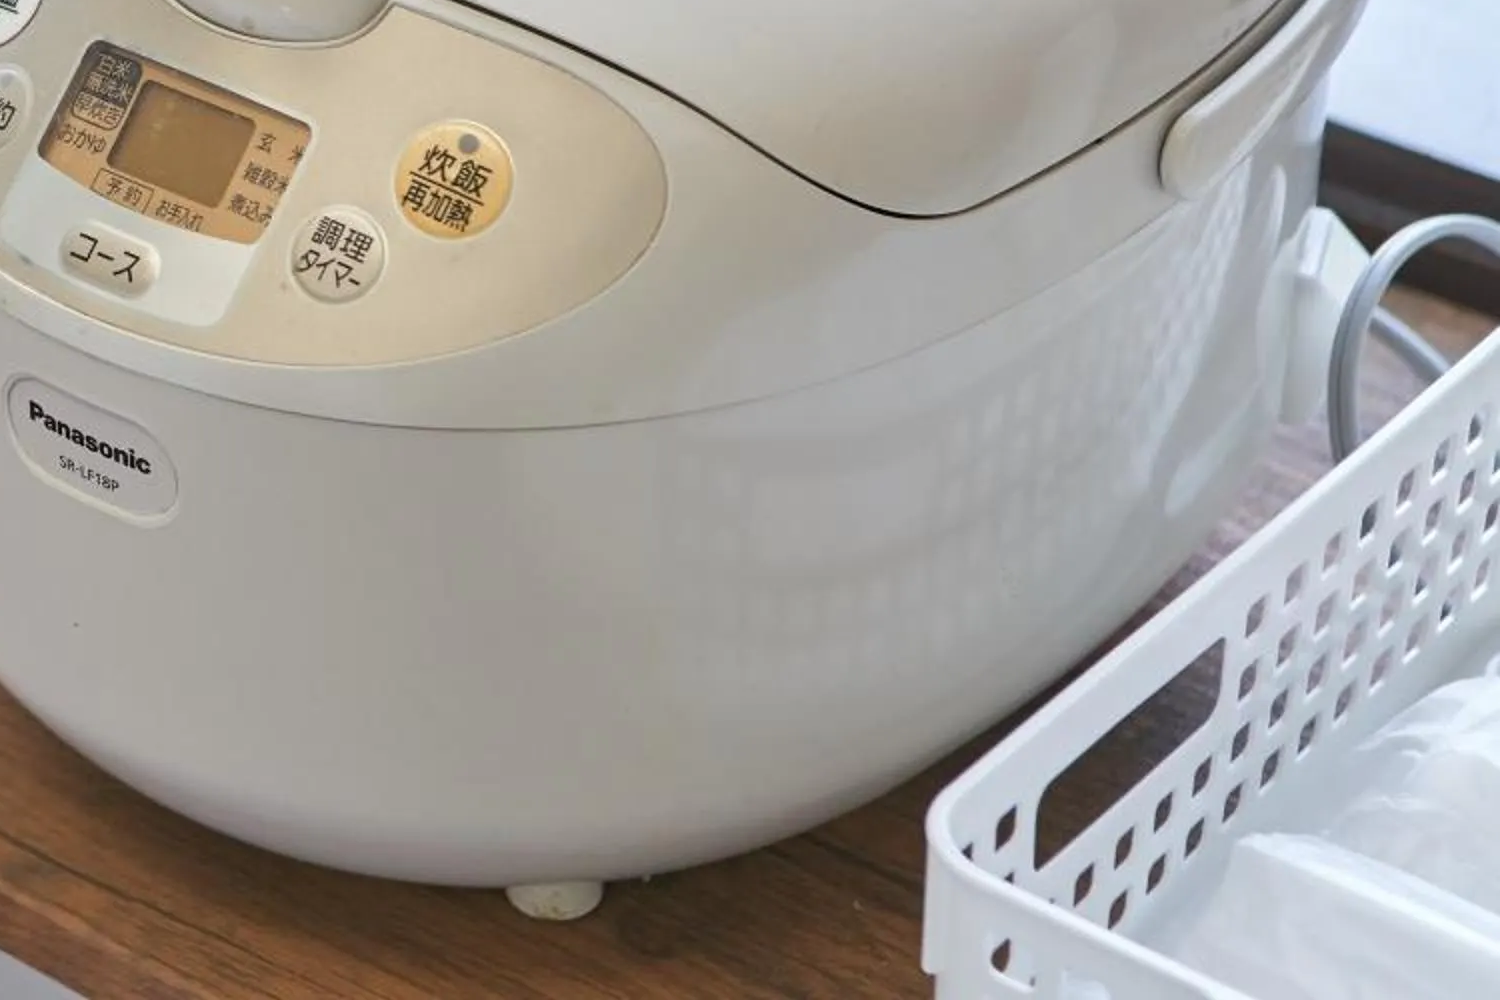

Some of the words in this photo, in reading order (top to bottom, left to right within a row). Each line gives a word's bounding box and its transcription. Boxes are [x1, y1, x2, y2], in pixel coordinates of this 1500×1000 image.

[59, 122, 107, 154] おかゆ
[106, 177, 143, 208] 予約
[418, 144, 494, 199] 炊飯
[401, 179, 474, 233] 再加熱
[69, 231, 141, 283] コース
[310, 215, 375, 264] 調理
[295, 248, 361, 289] タイマー
[28, 399, 152, 475] Panasonic
[59, 455, 121, 492] SR-LF18P
